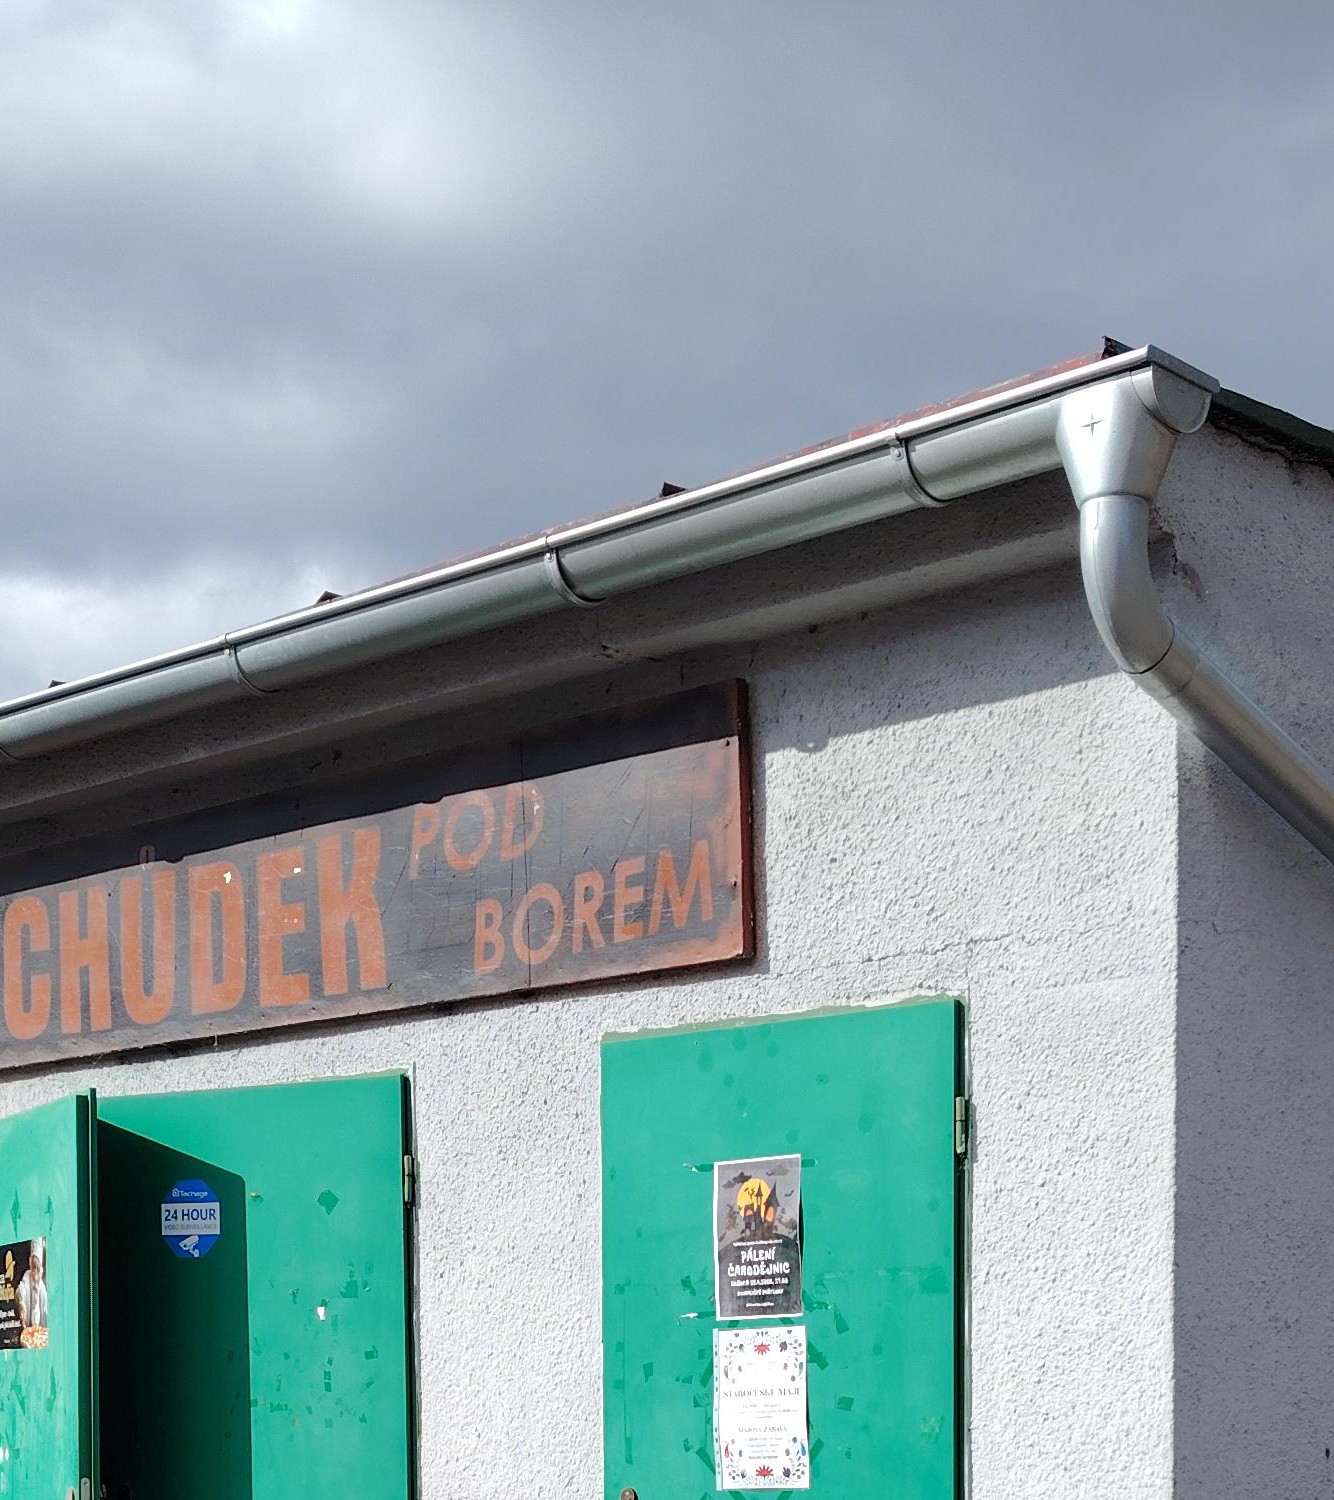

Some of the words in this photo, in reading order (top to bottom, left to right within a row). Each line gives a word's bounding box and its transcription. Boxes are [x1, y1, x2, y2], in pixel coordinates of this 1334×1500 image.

[408, 781, 544, 880] POD
[473, 838, 714, 975] BOREM
[164, 1209, 178, 1222] 24
[181, 1208, 217, 1221] HOUR
[740, 1246, 777, 1264] PÁLENÍ
[727, 1261, 791, 1277] ČARODĚJNIC
